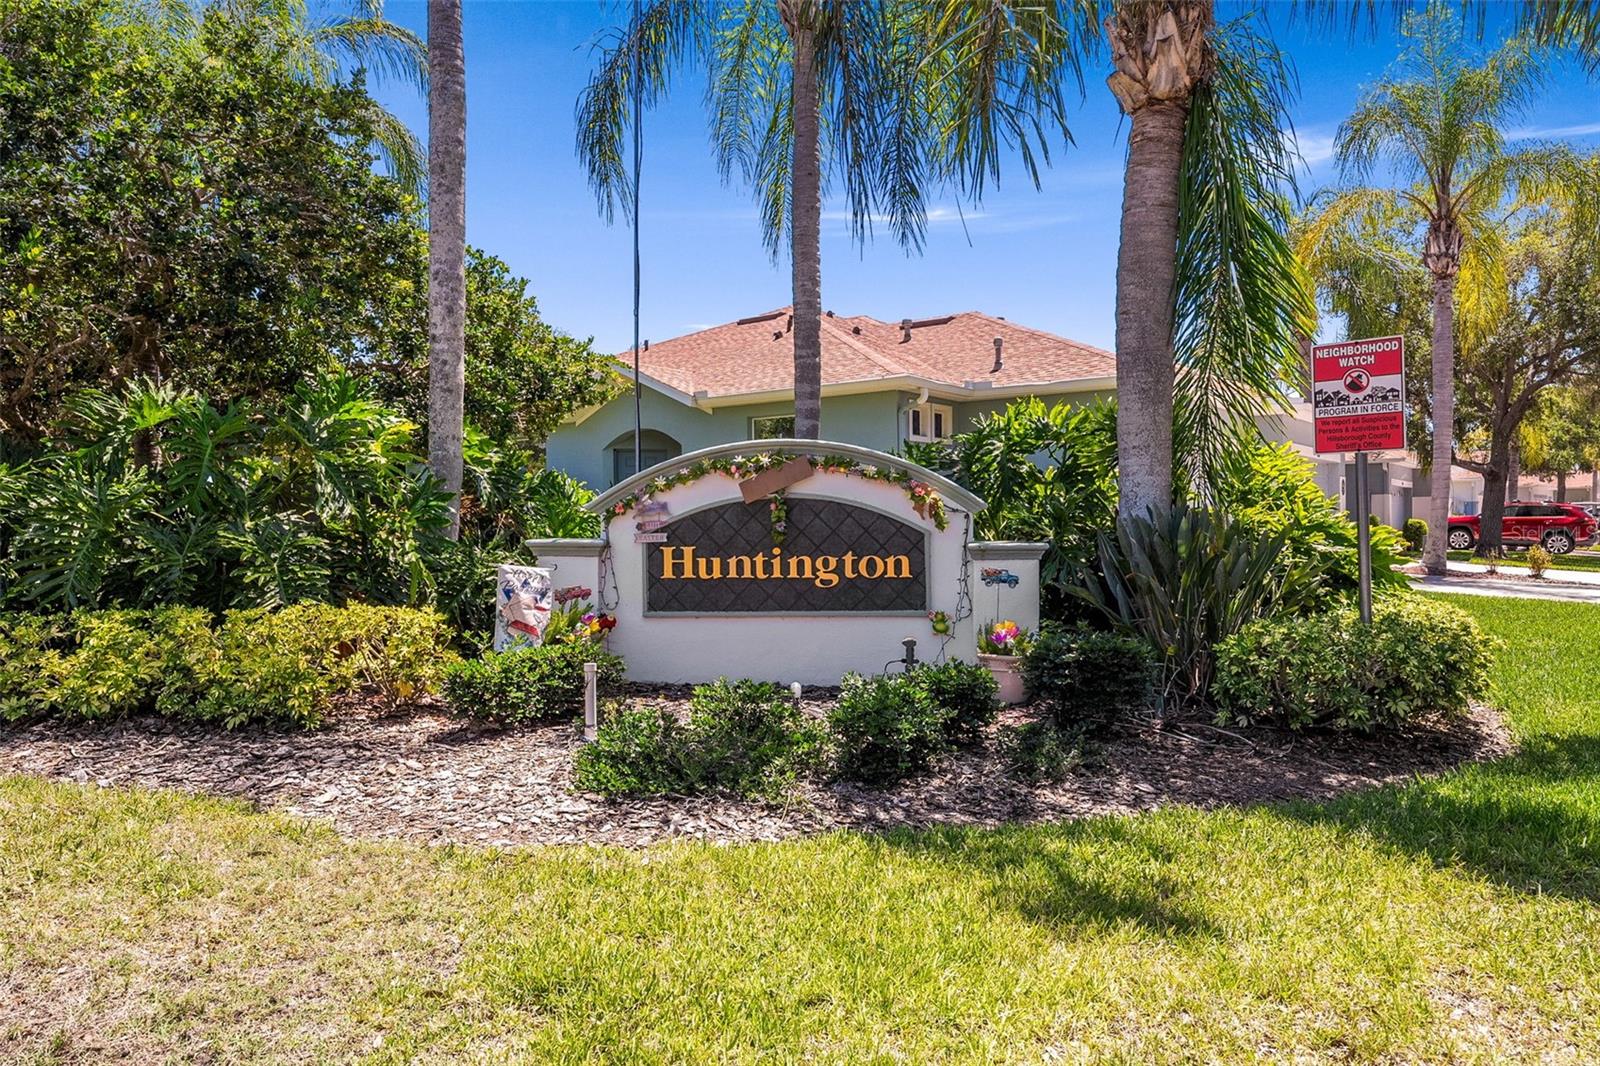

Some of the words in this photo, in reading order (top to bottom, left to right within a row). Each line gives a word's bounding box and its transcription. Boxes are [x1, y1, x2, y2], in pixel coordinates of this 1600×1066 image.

[1316, 341, 1399, 359] NEIGHBORHOOD
[1339, 355, 1375, 367] WATCH
[1318, 407, 1359, 416] PROGRAM
[1371, 403, 1399, 412] FORCE
[1361, 415, 1397, 423] Suspicious
[1327, 434, 1367, 442] Hillsborough
[1368, 432, 1391, 440] County
[660, 546, 912, 588] Huntington
